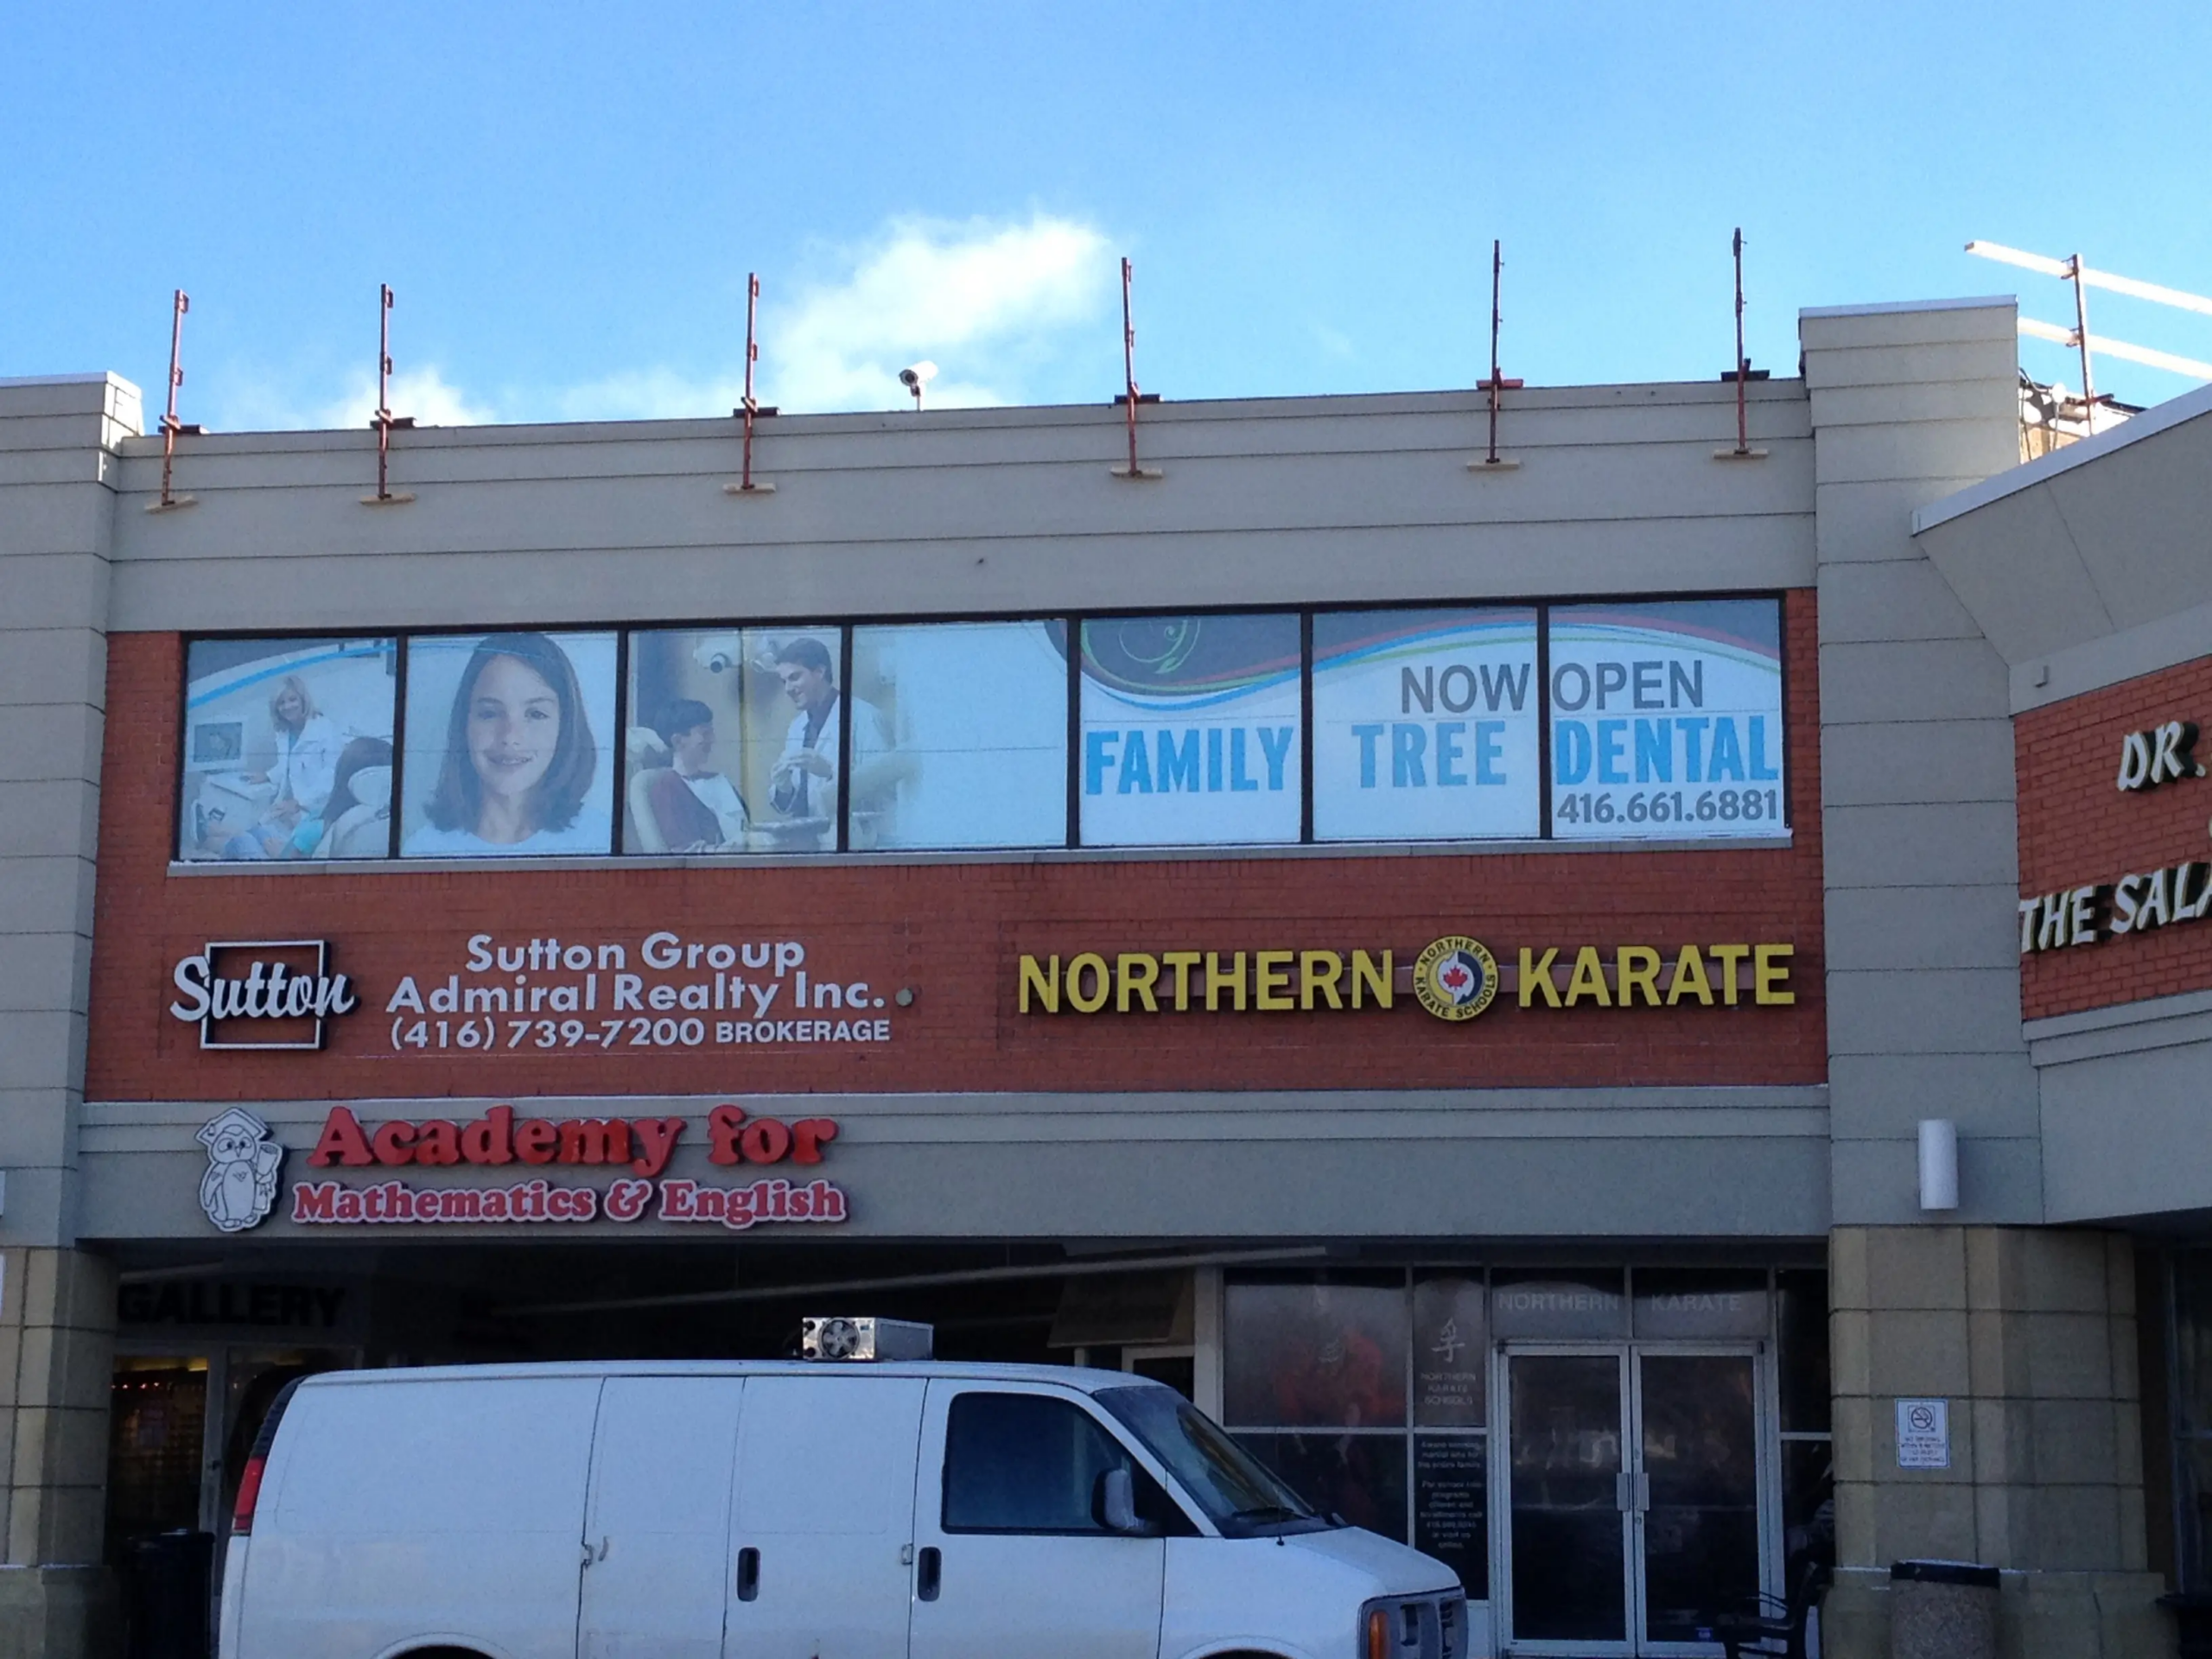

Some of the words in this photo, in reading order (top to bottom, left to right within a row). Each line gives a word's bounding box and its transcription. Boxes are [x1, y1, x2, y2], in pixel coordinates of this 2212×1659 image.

[1401, 664, 1530, 714] NOW
[1553, 659, 1703, 712] OPEN
[1085, 726, 1294, 796] FAMILY
[1351, 721, 1505, 788] TREE
[1555, 715, 1778, 785] DENTAL
[2117, 721, 2206, 791] DR.
[1557, 790, 1777, 824] 416.661.6881
[2019, 885, 2097, 953] THE
[467, 935, 626, 972] Sutton
[641, 931, 805, 976] Group
[1420, 938, 1491, 966] NORTHERN
[170, 954, 357, 1020] Sutton
[386, 974, 596, 1014] Admiral
[613, 972, 784, 1020] Realty
[796, 971, 886, 1009] Inc.
[1019, 949, 1394, 1014] NORTHERN
[1518, 944, 1796, 1008] KARATE
[1415, 976, 1450, 1017] KARATE
[1456, 974, 1496, 1018] SCHOOLS
[390, 1018, 496, 1051] (416)
[508, 1018, 705, 1047] 739-7200
[716, 1020, 891, 1043] BROKERAGE
[307, 1105, 687, 1177] Academy
[707, 1103, 841, 1166] for
[293, 1180, 596, 1224] Mathematics
[604, 1179, 652, 1222] &
[658, 1179, 848, 1230] English
[118, 1282, 346, 1327] GALLERY
[1498, 1293, 1619, 1312] NORTHERN
[1651, 1293, 1743, 1312] KARATE
